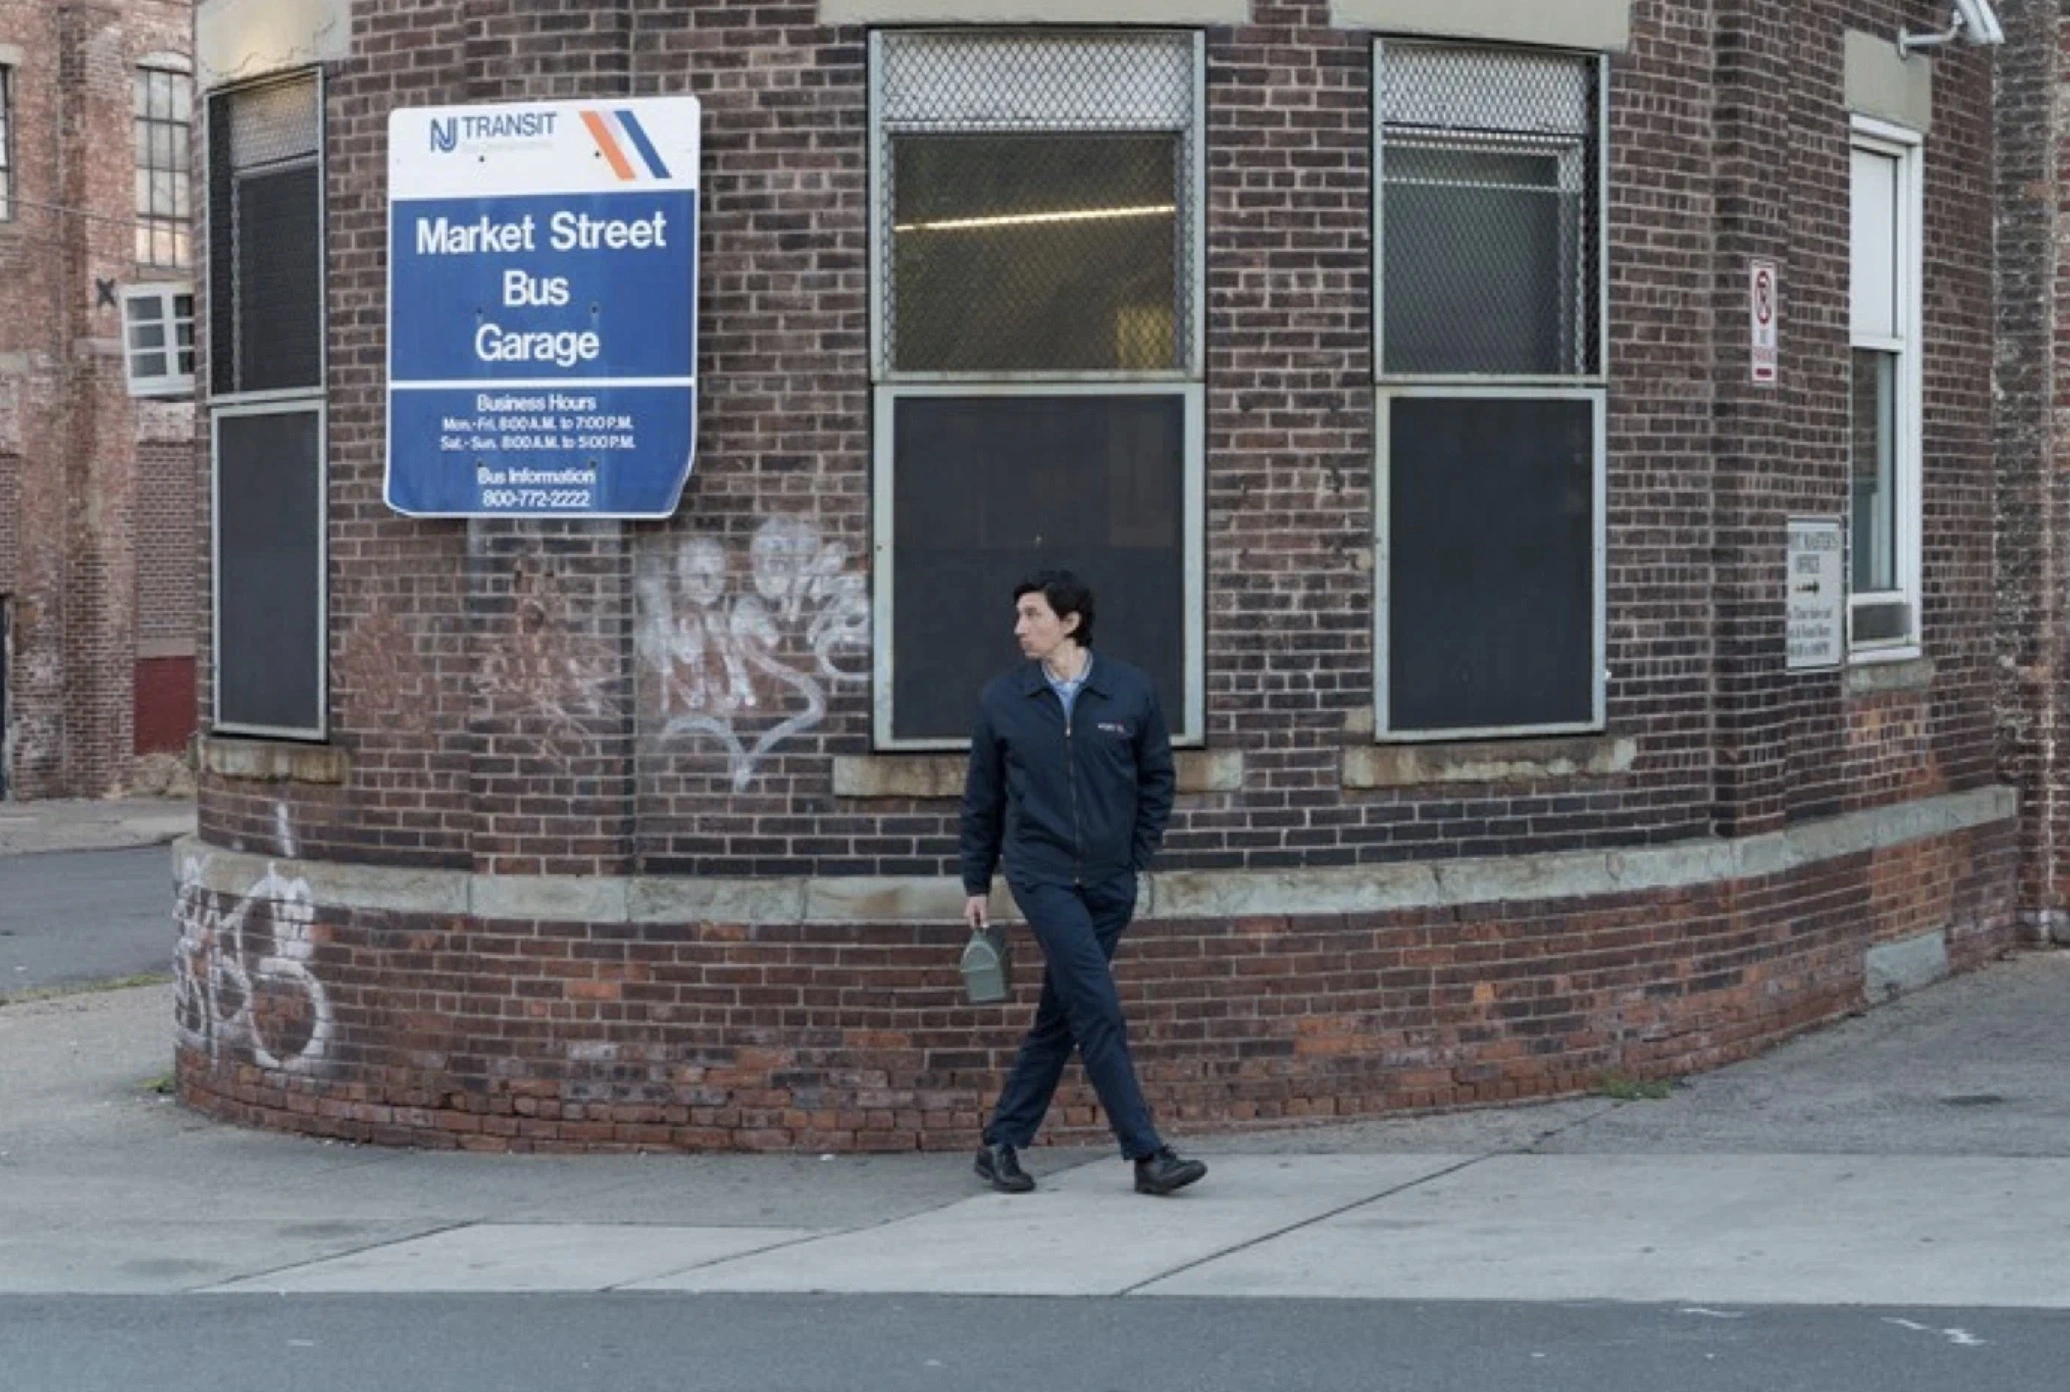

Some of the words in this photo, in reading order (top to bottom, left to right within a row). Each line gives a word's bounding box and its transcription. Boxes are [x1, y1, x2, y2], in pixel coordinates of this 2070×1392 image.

[463, 111, 557, 138] TRANSIT
[416, 214, 535, 255] Market
[551, 211, 667, 250] Street
[504, 269, 569, 308] Bus
[475, 323, 600, 367] Garage
[477, 393, 545, 412] Business
[548, 392, 597, 411] Hours
[559, 416, 574, 430] to
[562, 435, 576, 449] to
[477, 467, 506, 484] Bus
[508, 466, 596, 484] Information
[482, 489, 591, 507] 800-772-2222
